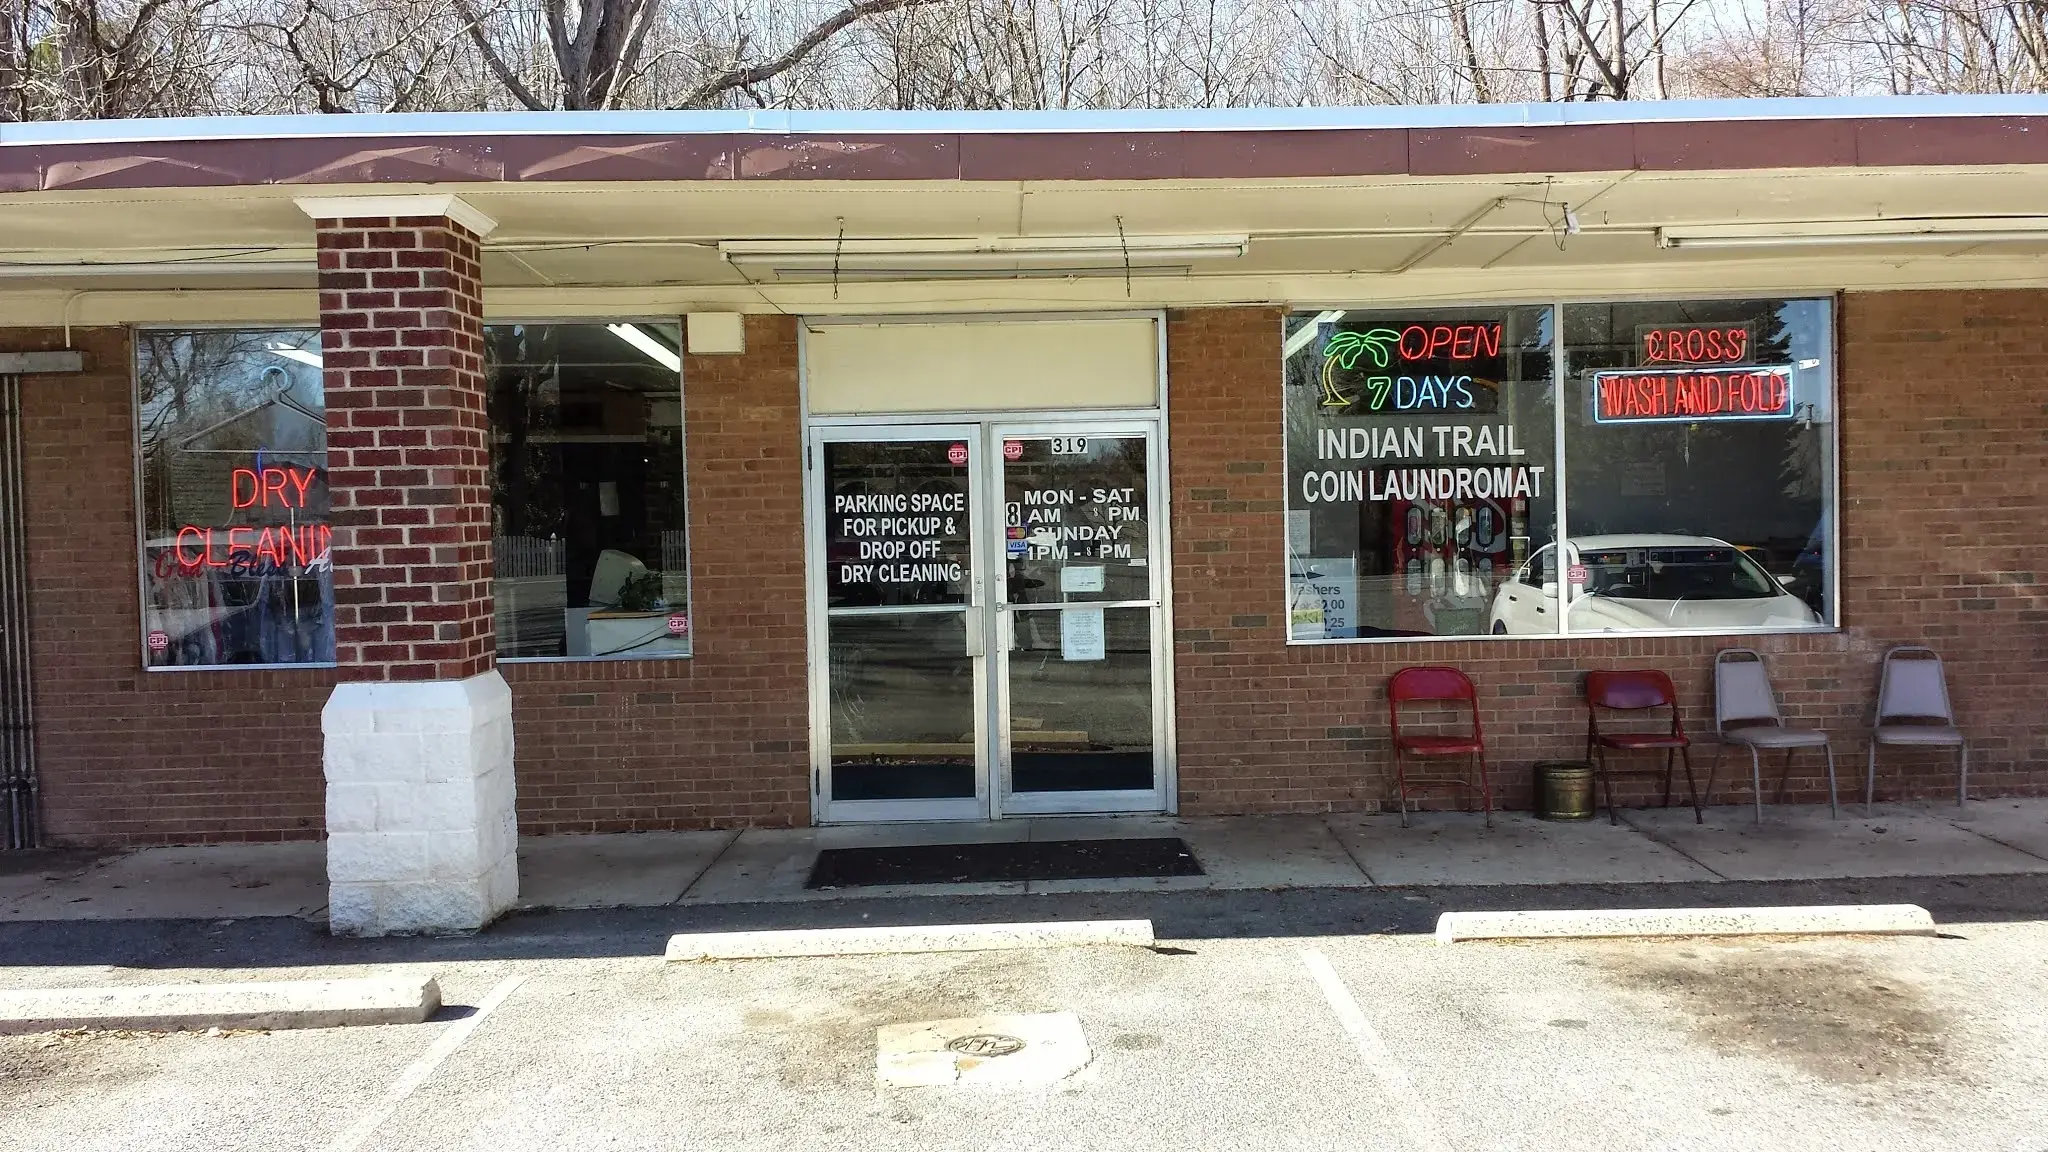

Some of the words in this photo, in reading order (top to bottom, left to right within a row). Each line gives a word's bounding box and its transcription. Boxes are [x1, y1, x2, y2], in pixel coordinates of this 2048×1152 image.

[1399, 325, 1502, 360] OPEN
[1367, 376, 1392, 410] 7
[1396, 375, 1474, 409] DAYS
[1603, 375, 1667, 416] WASH
[1674, 374, 1722, 413] AND
[1728, 372, 1787, 412] FOLD
[1052, 438, 1087, 453] 319
[1317, 426, 1424, 460] INDIAN
[1432, 424, 1525, 457] TRAIL
[232, 468, 316, 508] DRY
[1302, 470, 1363, 503] COIN
[1369, 466, 1545, 501] LAUNDROMAT
[835, 494, 907, 513] PARKING
[911, 493, 965, 512] SPACE
[1024, 489, 1074, 505] MON
[1092, 488, 1135, 504] SAT
[1007, 503, 1019, 526] 8
[1027, 508, 1061, 524] AM
[1093, 507, 1099, 517] 8
[1108, 506, 1140, 521] PM
[843, 518, 877, 537] FOR
[881, 517, 941, 536] PICKUP
[945, 516, 957, 535] &
[860, 541, 906, 560] DROP
[909, 540, 941, 559] OFF
[1009, 541, 1026, 549] VISA
[1027, 545, 1069, 561] 1PM
[1086, 546, 1092, 557] 8
[1100, 543, 1131, 559] PM
[841, 564, 875, 584] DRY
[878, 563, 961, 583] CLEANING
